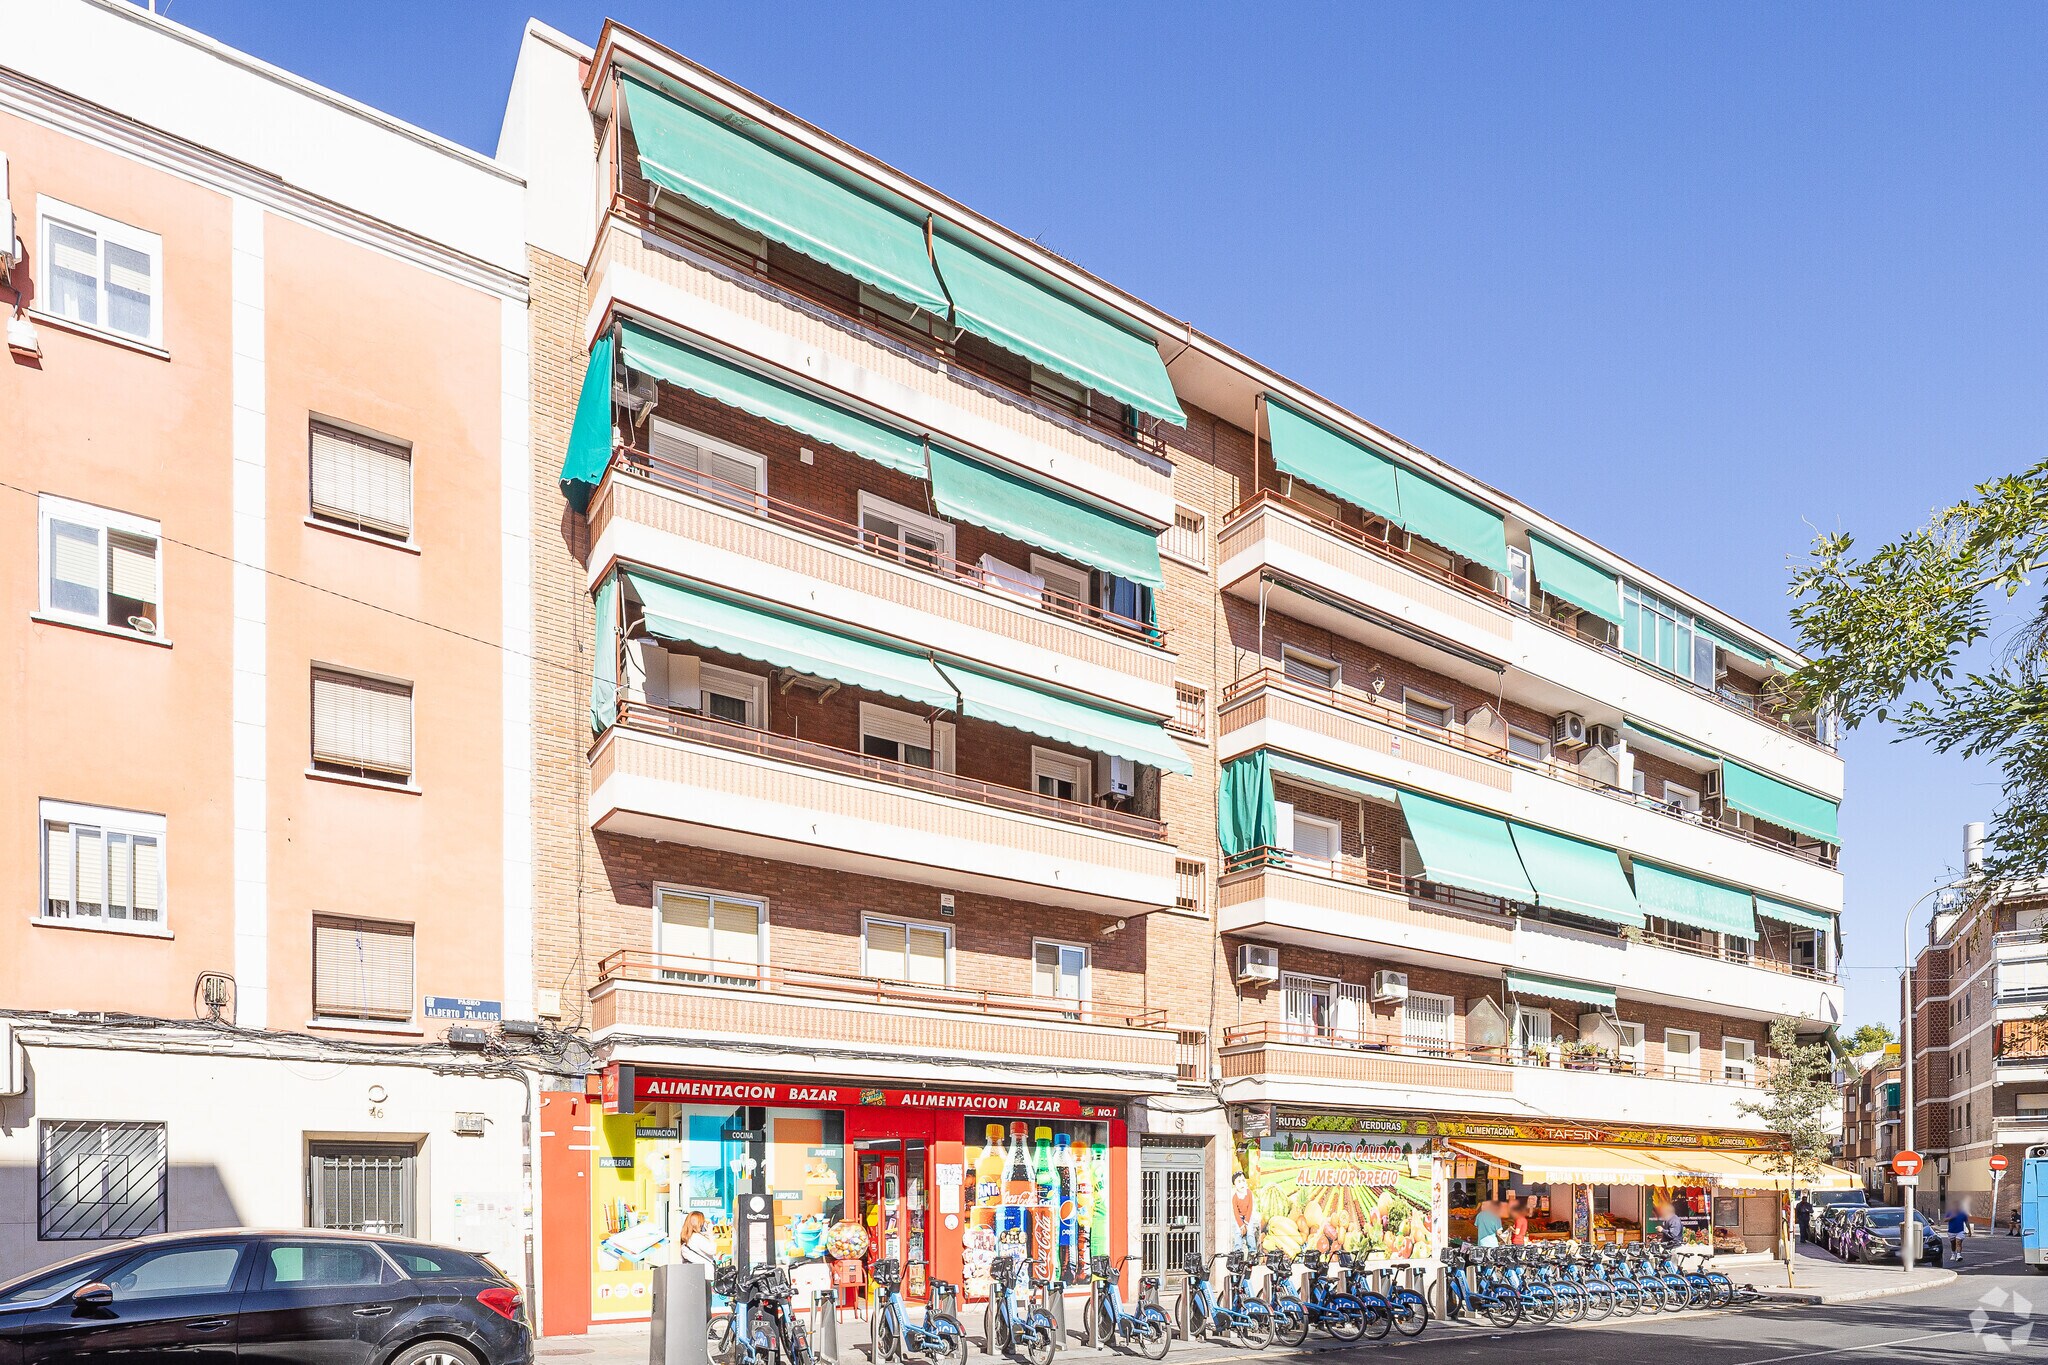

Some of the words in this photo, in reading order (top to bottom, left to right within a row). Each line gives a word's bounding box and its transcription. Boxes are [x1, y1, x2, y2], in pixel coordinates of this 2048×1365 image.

[428, 1008, 460, 1018] ALBERTO
[463, 1010, 499, 1020] PALACIOS
[647, 1081, 776, 1099] ALIMENTACION
[789, 1088, 837, 1101] BAZAR
[901, 1093, 1008, 1109] ALIMENTACION
[1019, 1099, 1060, 1112] BAZAR
[1097, 1108, 1116, 1117] NO.1
[1360, 1120, 1401, 1130] VERDURAS
[636, 1127, 676, 1137] ILUMINACIÓN
[732, 1131, 753, 1140] COCINA
[1545, 1128, 1599, 1140] TAFSIN
[1292, 1142, 1308, 1160] LA
[1310, 1143, 1351, 1161] MEJOR
[1355, 1145, 1401, 1162] CALIDAD
[600, 1158, 631, 1167] PAPELERÍA
[1297, 1169, 1312, 1184] AL
[1314, 1170, 1356, 1185] MEJOR
[1359, 1170, 1399, 1186] PRECIO
